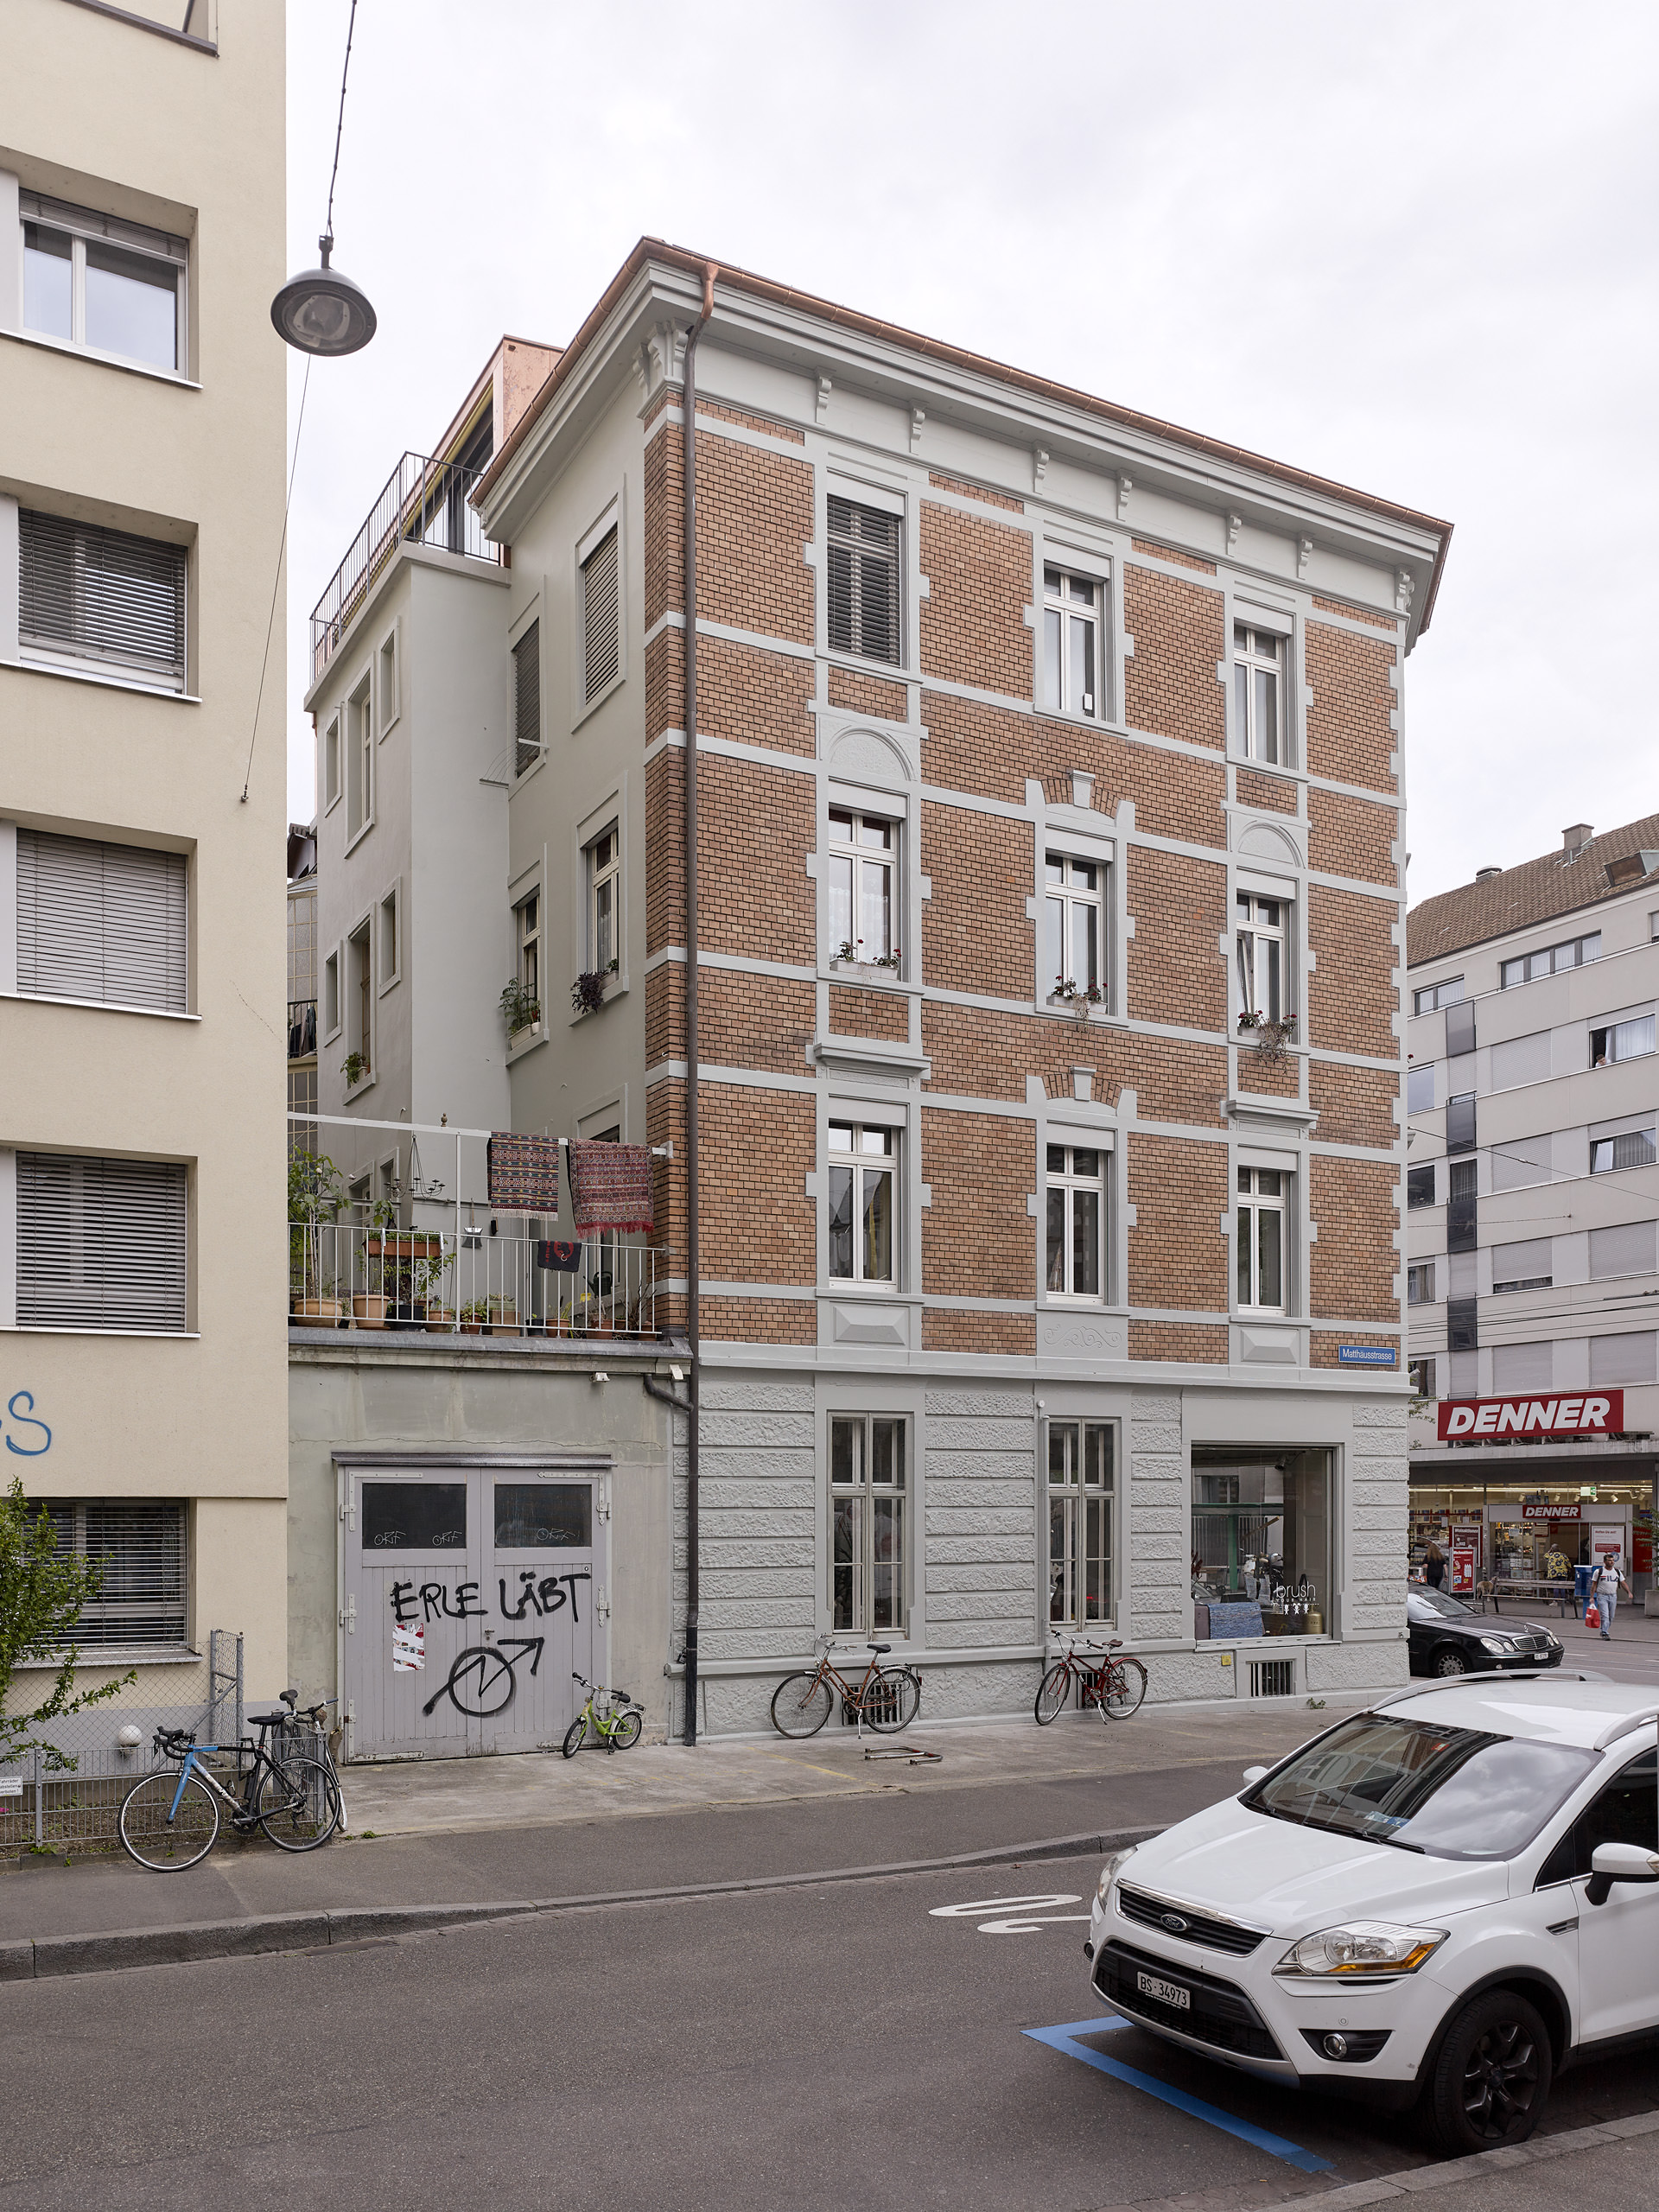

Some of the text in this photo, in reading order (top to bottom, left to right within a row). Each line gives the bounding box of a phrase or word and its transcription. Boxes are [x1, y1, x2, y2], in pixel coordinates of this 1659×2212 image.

[1342, 1348, 1393, 1361] Matthäusstrasse
[0, 1389, 52, 1457] S
[1446, 1397, 1611, 1435] DENNER
[1525, 1506, 1579, 1517] DENNER
[390, 1571, 591, 1623] ERLE LÄBT
[1276, 1580, 1316, 1599] brush
[1165, 1916, 1180, 1929] Ford
